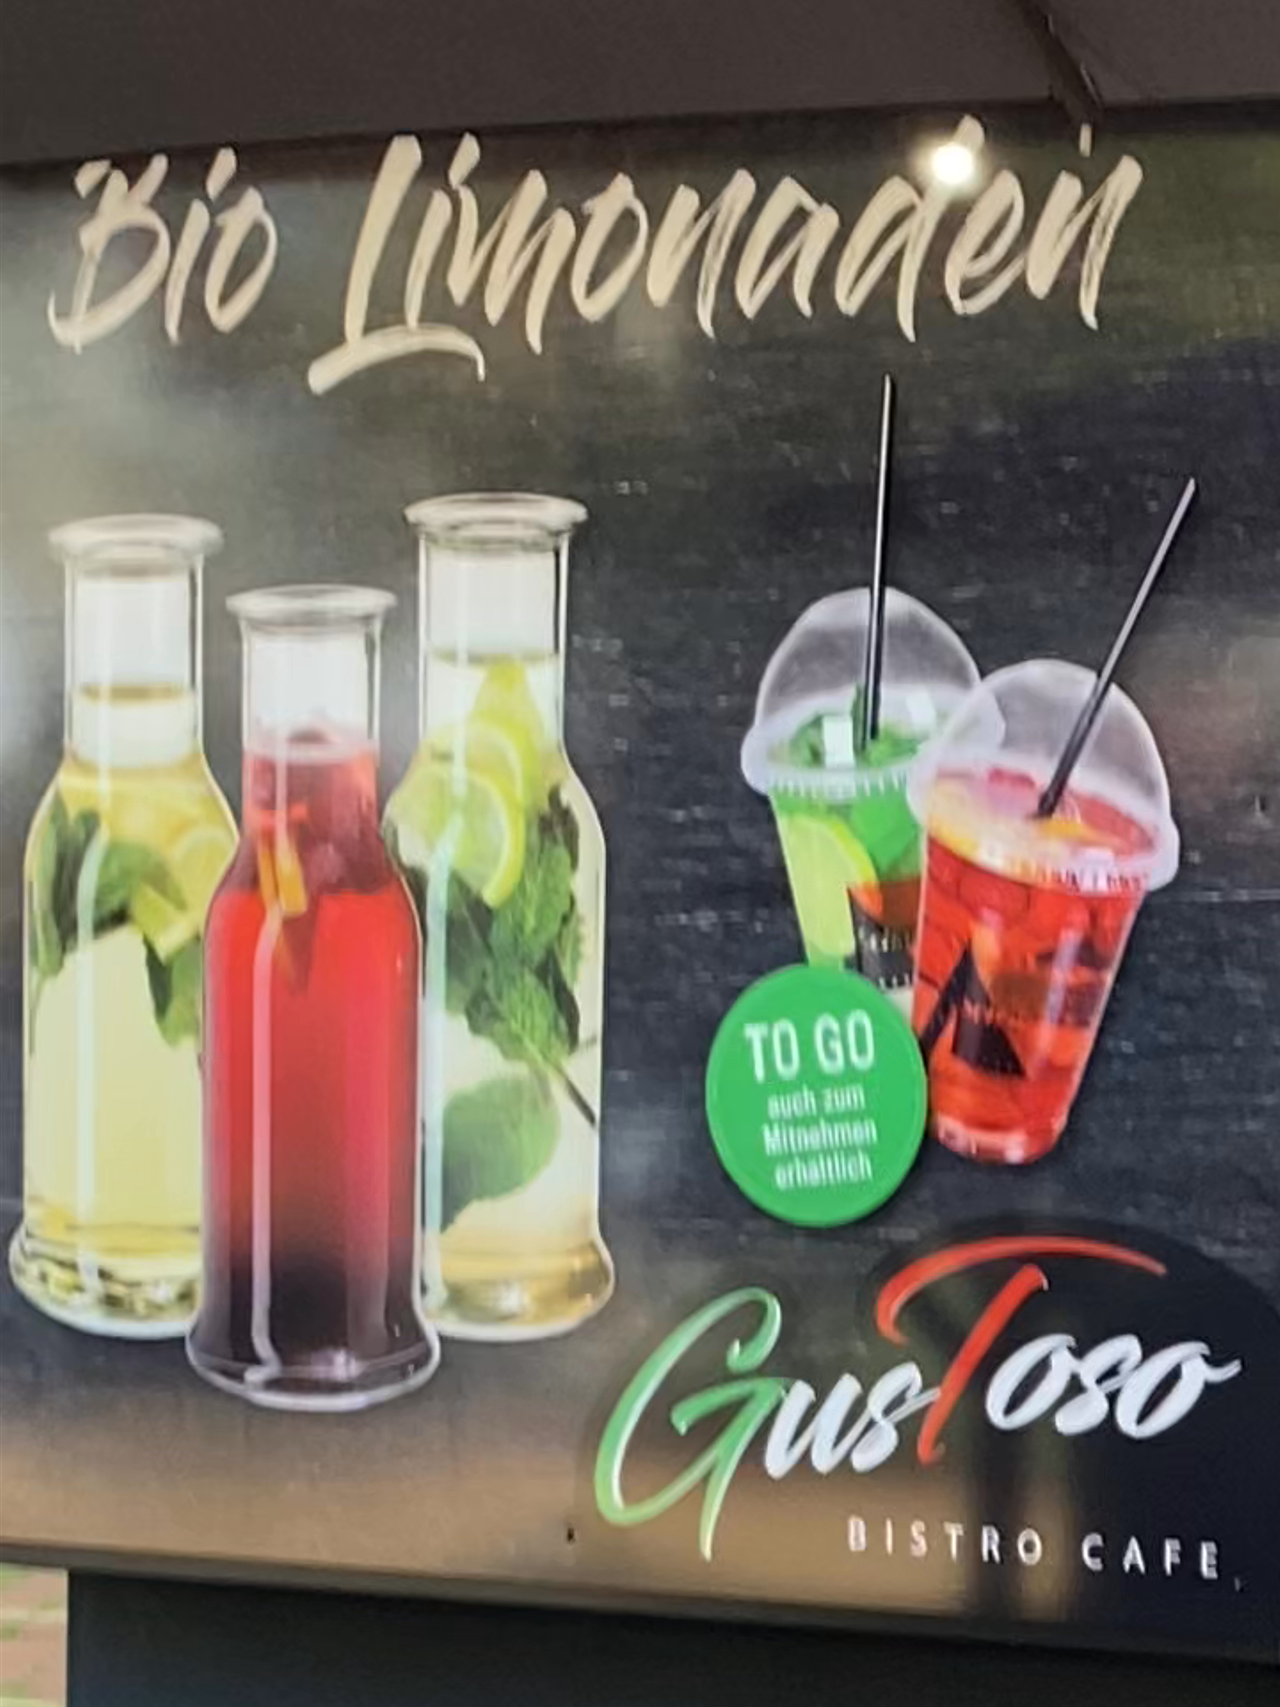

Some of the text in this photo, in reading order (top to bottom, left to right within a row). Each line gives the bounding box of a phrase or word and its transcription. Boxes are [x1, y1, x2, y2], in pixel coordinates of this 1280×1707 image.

[47, 113, 1143, 394] Bio Limonaden
[744, 1009, 875, 1083] TO GO
[767, 1084, 866, 1119] auch zum
[762, 1118, 878, 1156] Mitnehmen
[847, 1515, 1220, 1579] BISTRO CAFE
